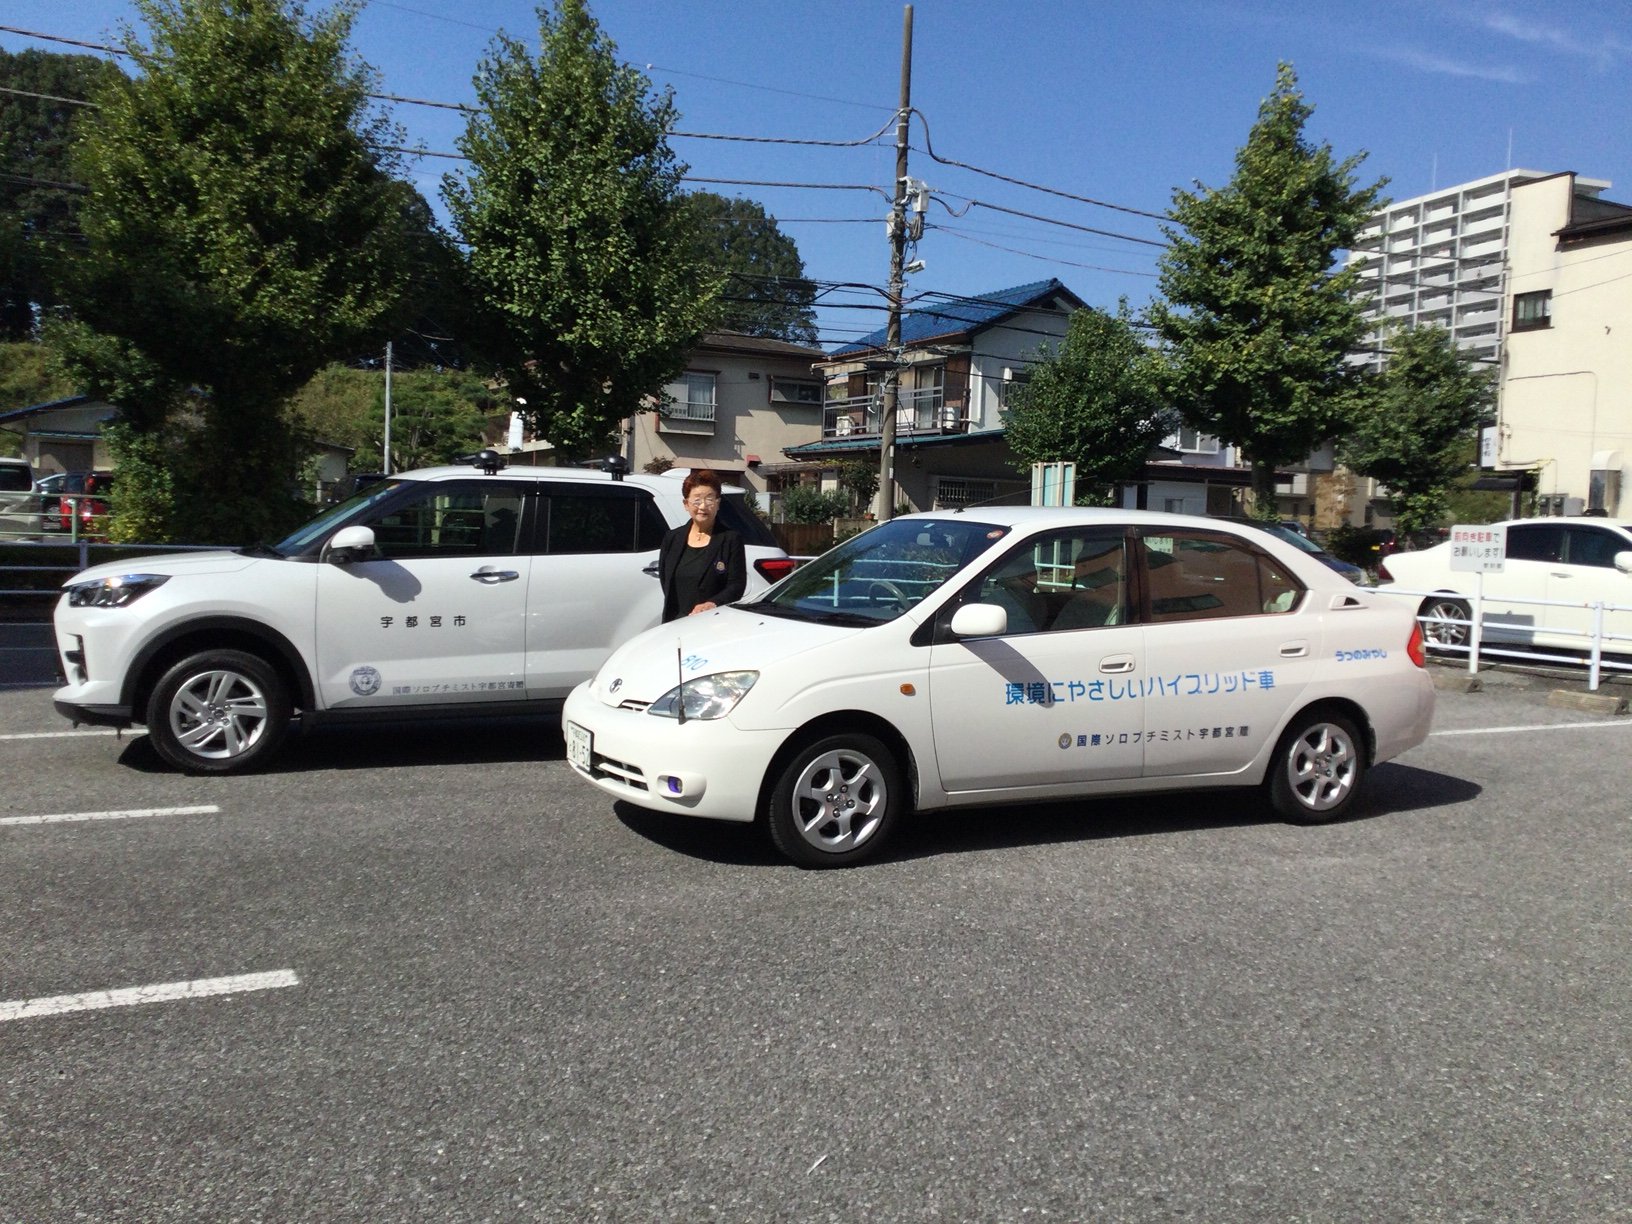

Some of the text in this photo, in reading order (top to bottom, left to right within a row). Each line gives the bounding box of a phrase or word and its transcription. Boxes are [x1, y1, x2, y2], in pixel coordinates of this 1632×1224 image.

[1454, 531, 1500, 544] 前向き駐車で
[380, 615, 467, 629] 宇都宮市
